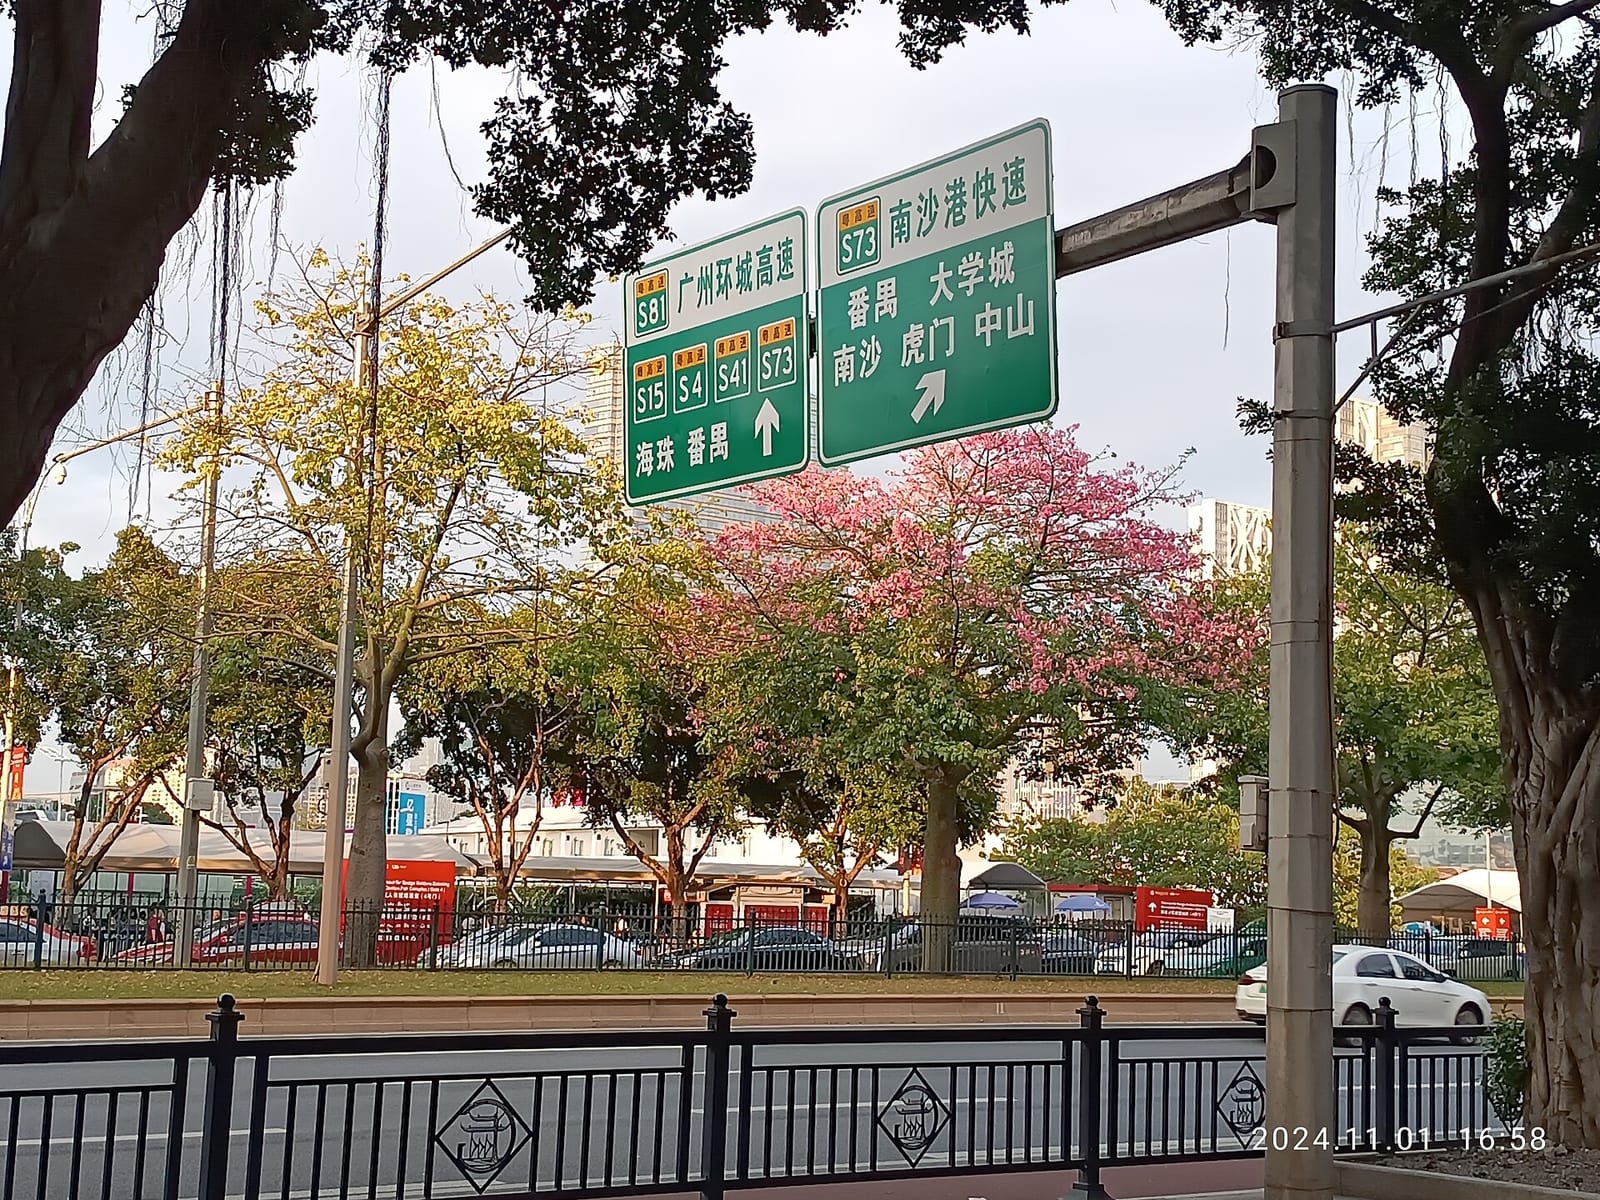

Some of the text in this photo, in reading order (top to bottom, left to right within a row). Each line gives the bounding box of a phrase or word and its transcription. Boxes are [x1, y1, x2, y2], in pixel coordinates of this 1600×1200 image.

[888, 155, 1027, 249] 南沙港快速
[841, 226, 876, 264] S73
[677, 236, 795, 314] 广州环城高速
[847, 241, 1015, 330] 番禺 大学城
[638, 294, 666, 329] S81
[833, 293, 1035, 387] 南沙 虎门 中山
[718, 358, 747, 392] S41
[761, 345, 792, 380] S73
[637, 381, 664, 414] S15
[679, 370, 702, 403] S4
[635, 421, 728, 478] 海珠 番禺
